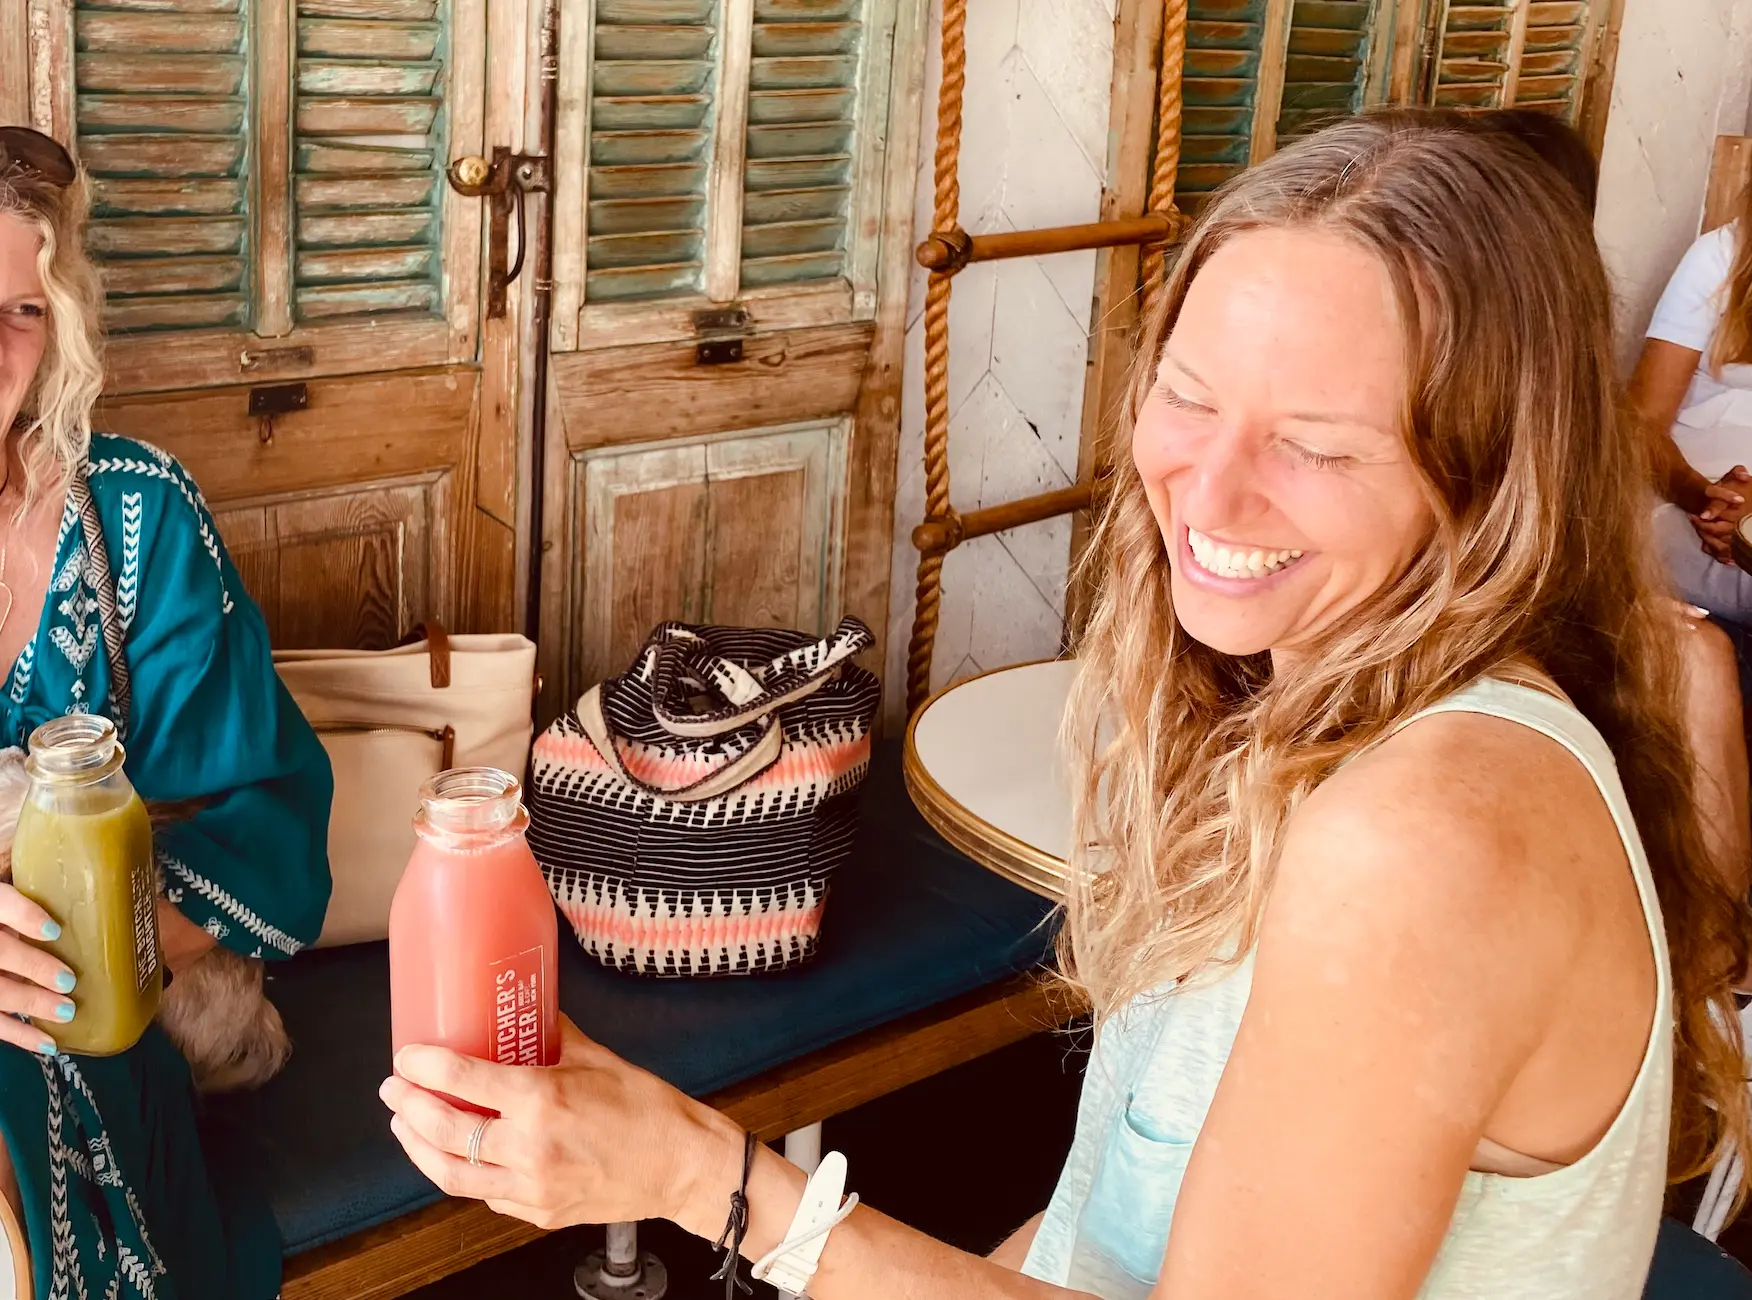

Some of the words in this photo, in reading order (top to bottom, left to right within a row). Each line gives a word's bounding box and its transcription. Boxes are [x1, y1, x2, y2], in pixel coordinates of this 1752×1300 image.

[138, 952, 147, 987] THE
[143, 889, 157, 974] DAUGHTER
[496, 969, 516, 1066] UTCHER'S
